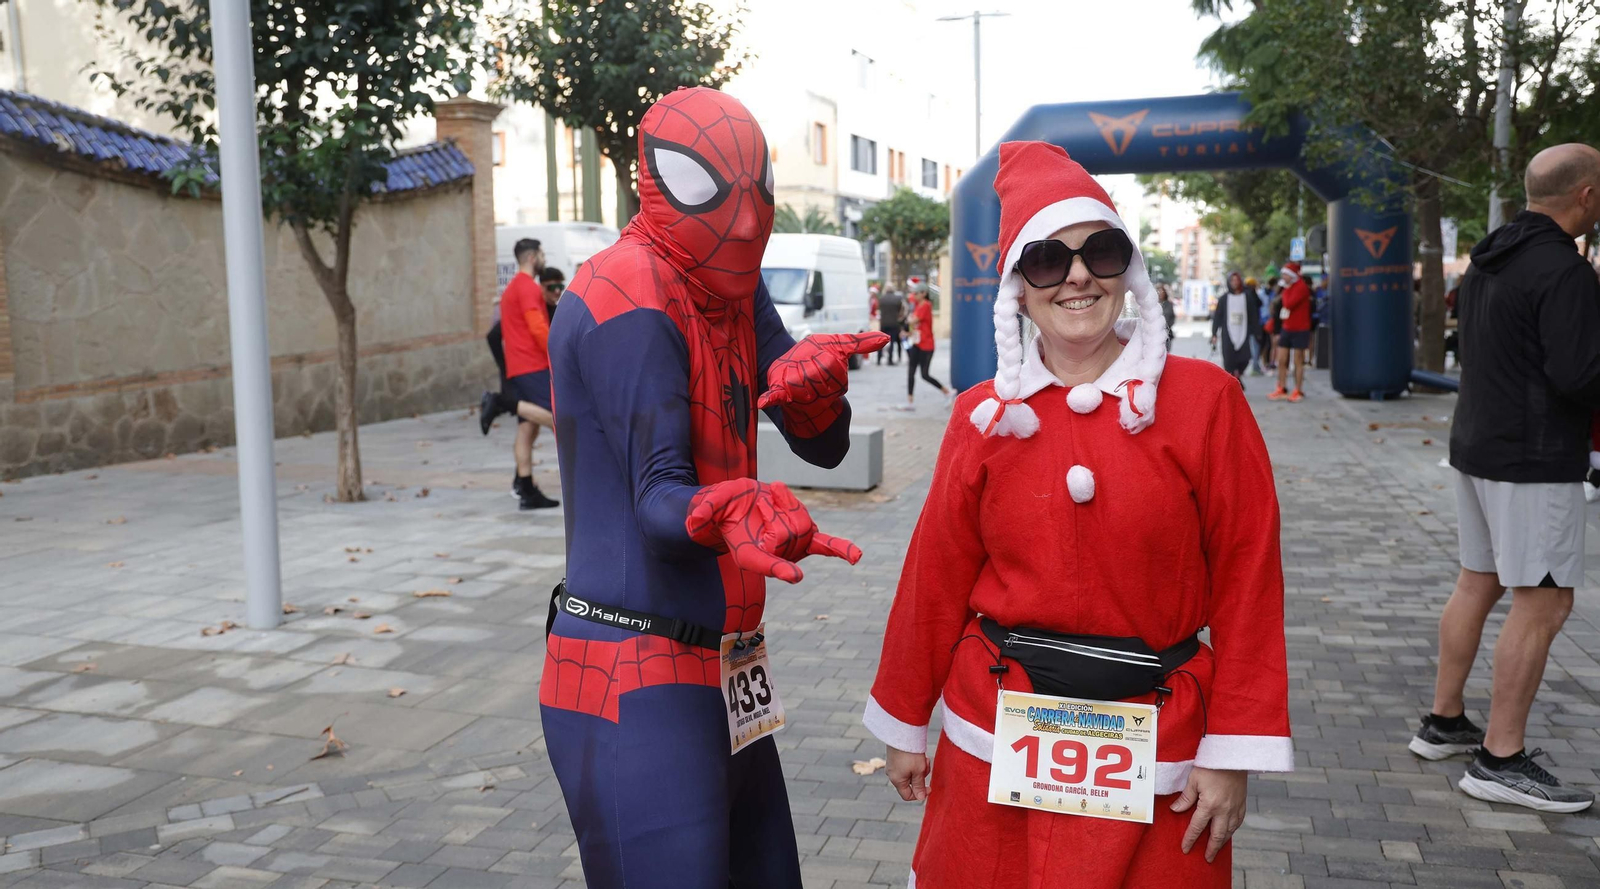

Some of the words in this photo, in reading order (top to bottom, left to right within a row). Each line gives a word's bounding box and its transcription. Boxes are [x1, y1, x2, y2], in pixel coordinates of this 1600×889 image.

[1151, 120, 1262, 138] CUPR
[1159, 141, 1256, 158] TURIAL
[591, 606, 652, 631] Kalenji
[728, 664, 772, 719] 433
[1058, 702, 1067, 710] XI
[1067, 703, 1093, 712] EDICIÓN
[1026, 705, 1076, 728] CARRERA
[1077, 711, 1125, 732] NAVIDAD
[1087, 730, 1123, 740] ALGECIRAS
[1010, 734, 1133, 790] 192
[1032, 781, 1063, 793] GRONDONA
[1065, 786, 1089, 796] GARCÍA,
[1090, 788, 1109, 798] BELEN
